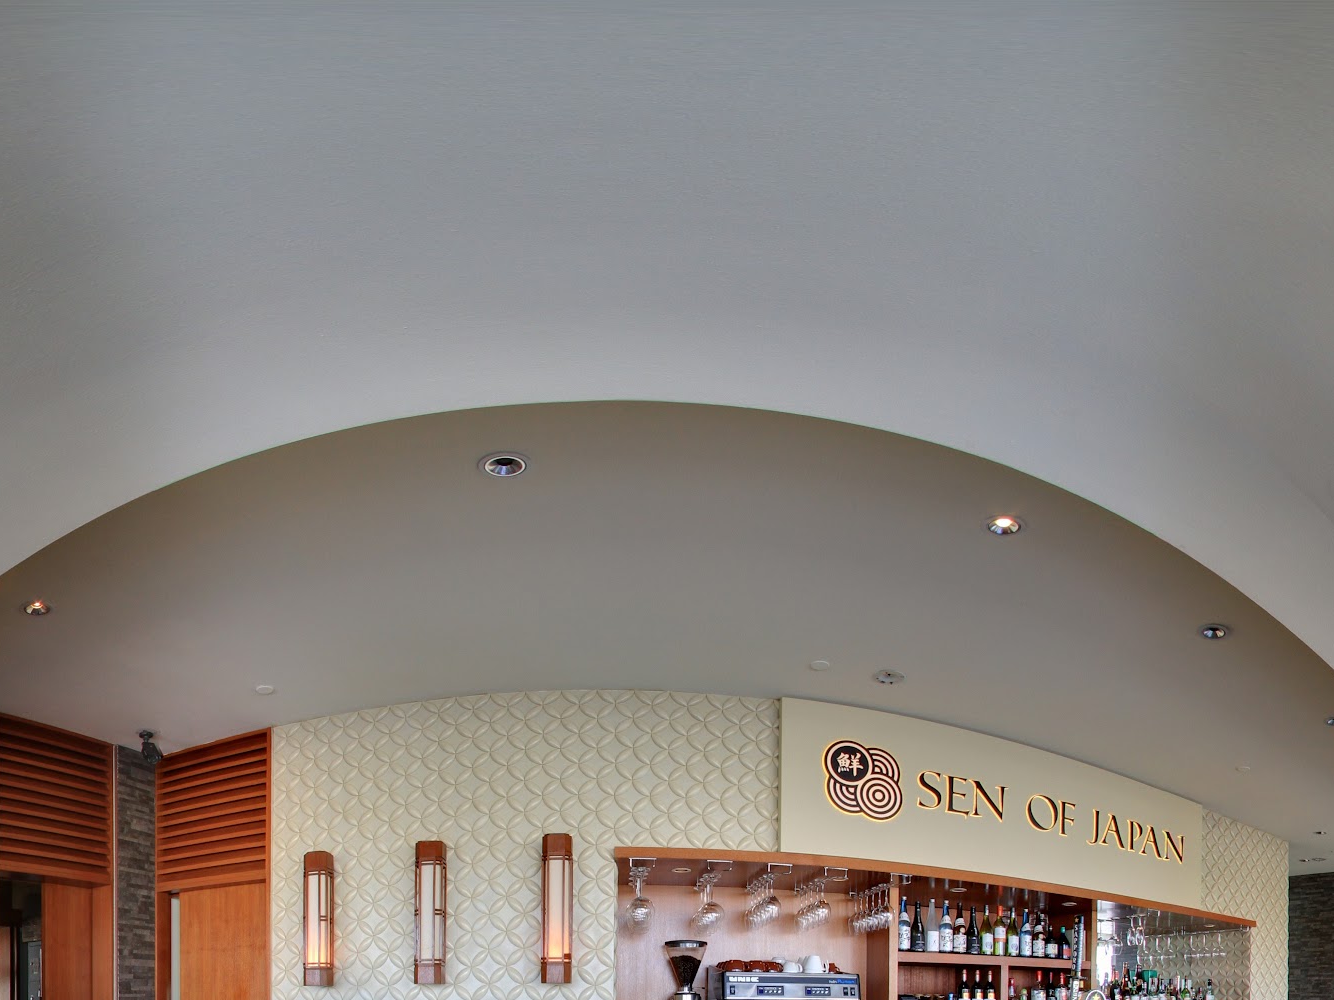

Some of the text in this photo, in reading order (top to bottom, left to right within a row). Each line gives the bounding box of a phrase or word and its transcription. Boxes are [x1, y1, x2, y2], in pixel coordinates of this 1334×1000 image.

[836, 751, 865, 776] 鮮
[916, 770, 1185, 864] SEN OF JAPAN
